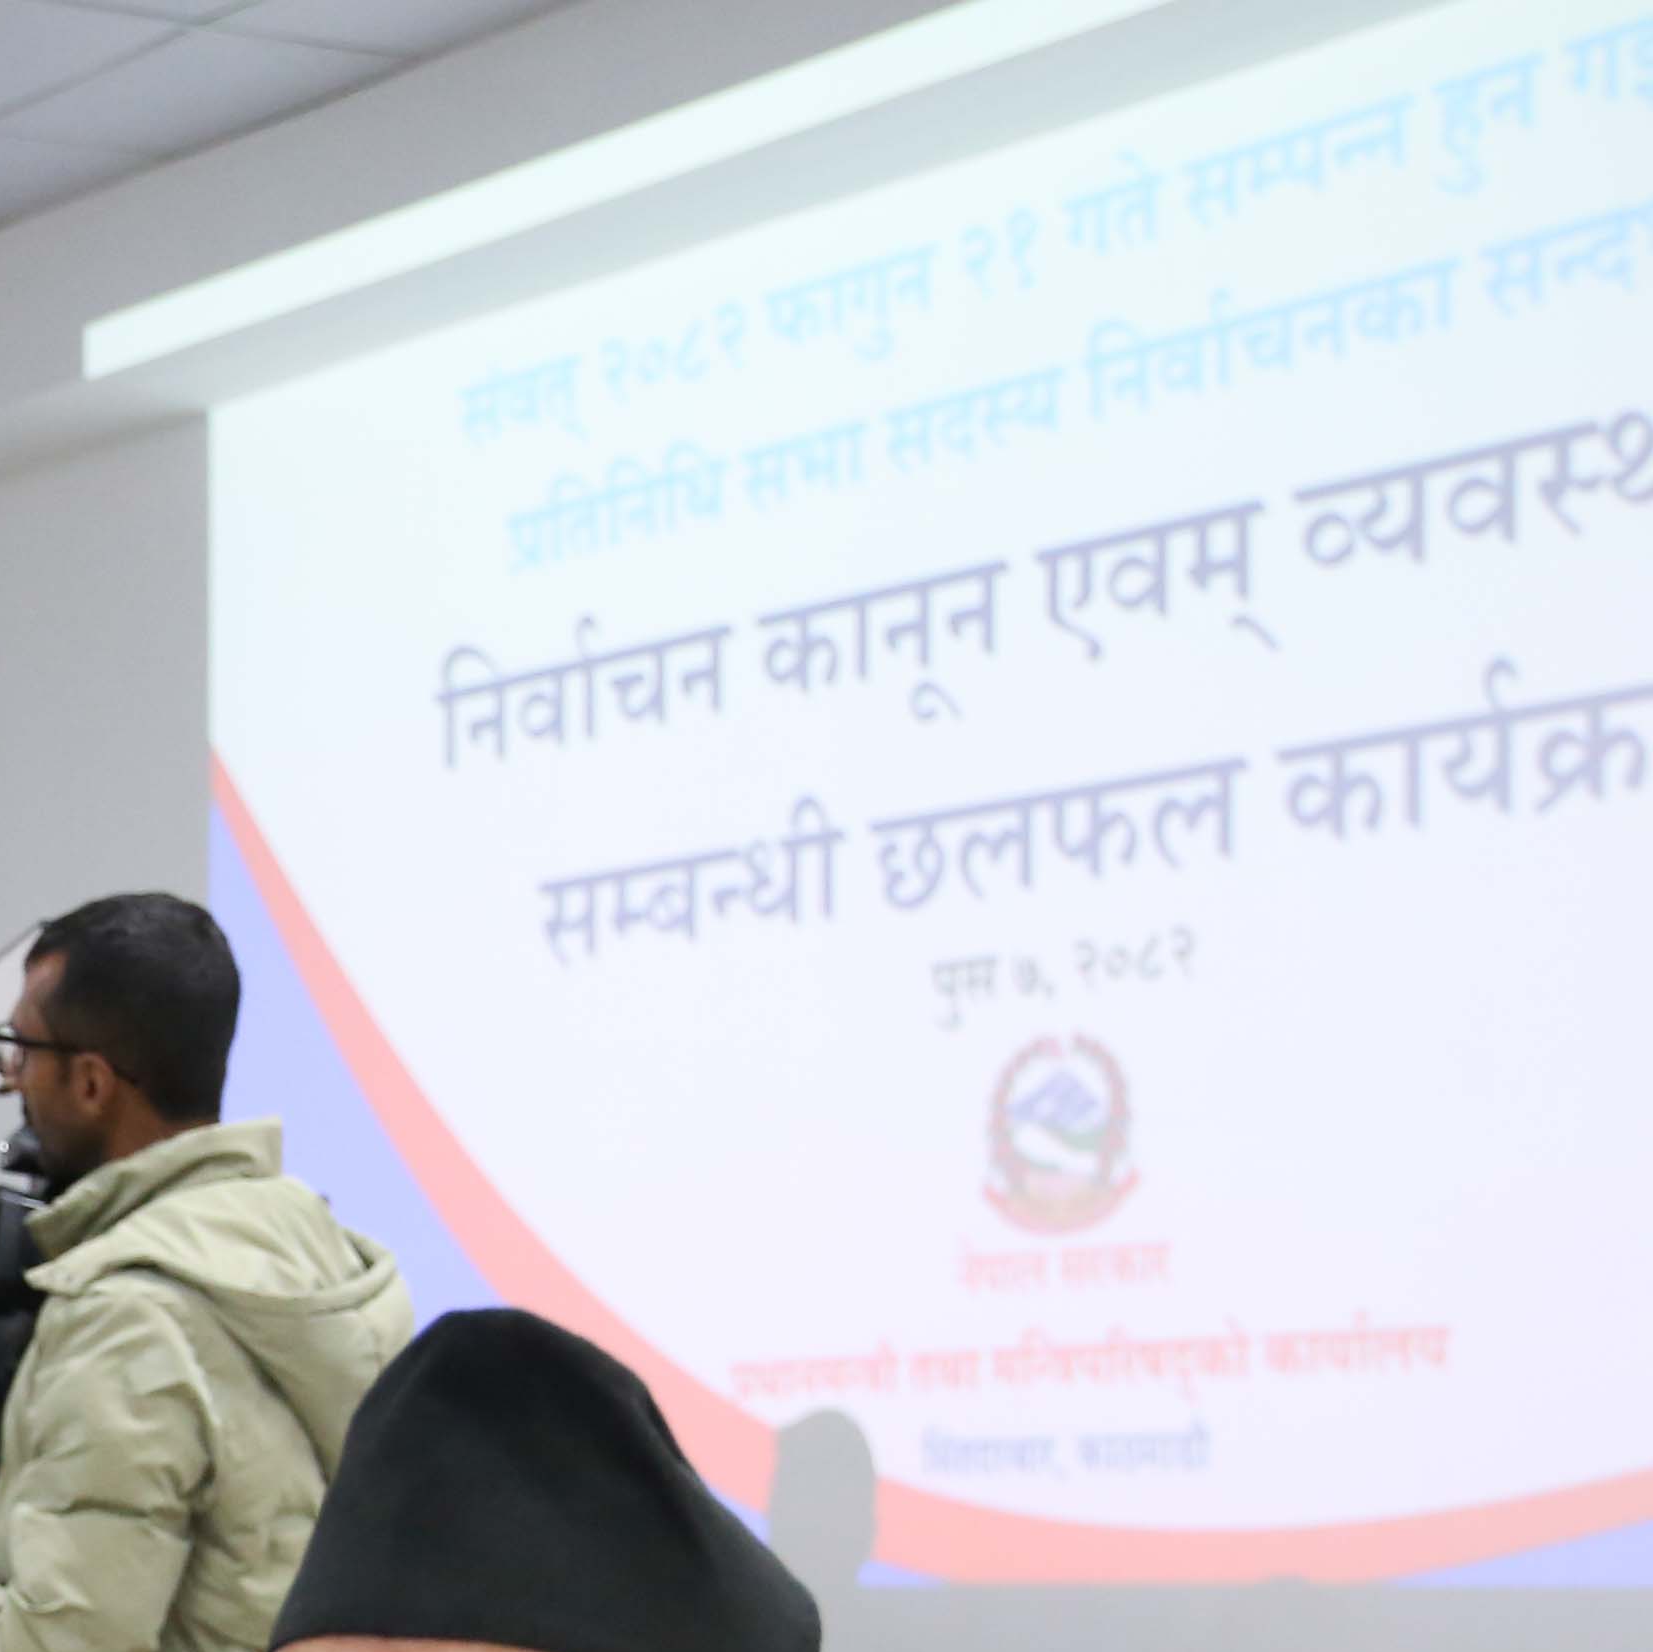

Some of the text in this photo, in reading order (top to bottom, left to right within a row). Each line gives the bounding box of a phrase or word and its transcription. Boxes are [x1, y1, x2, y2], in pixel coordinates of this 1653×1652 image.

[599, 300, 748, 402] २०८२
[762, 241, 938, 364] फागुन
[959, 206, 1040, 297] २१
[1062, 149, 1162, 255] गते
[1183, 93, 1416, 226] सम्पन्न
[1432, 50, 1546, 196] हुन
[506, 200, 1653, 575] प्रतिनिधि सभा सदस्य निर्वाचनका सन्द
[434, 611, 733, 770] निर्वाचन
[754, 559, 1010, 724] कानून
[1034, 499, 1282, 664] एवम्
[537, 793, 847, 969] सम्बन्धी
[867, 754, 1251, 912] छलफल
[1074, 924, 1198, 993] २०८२
